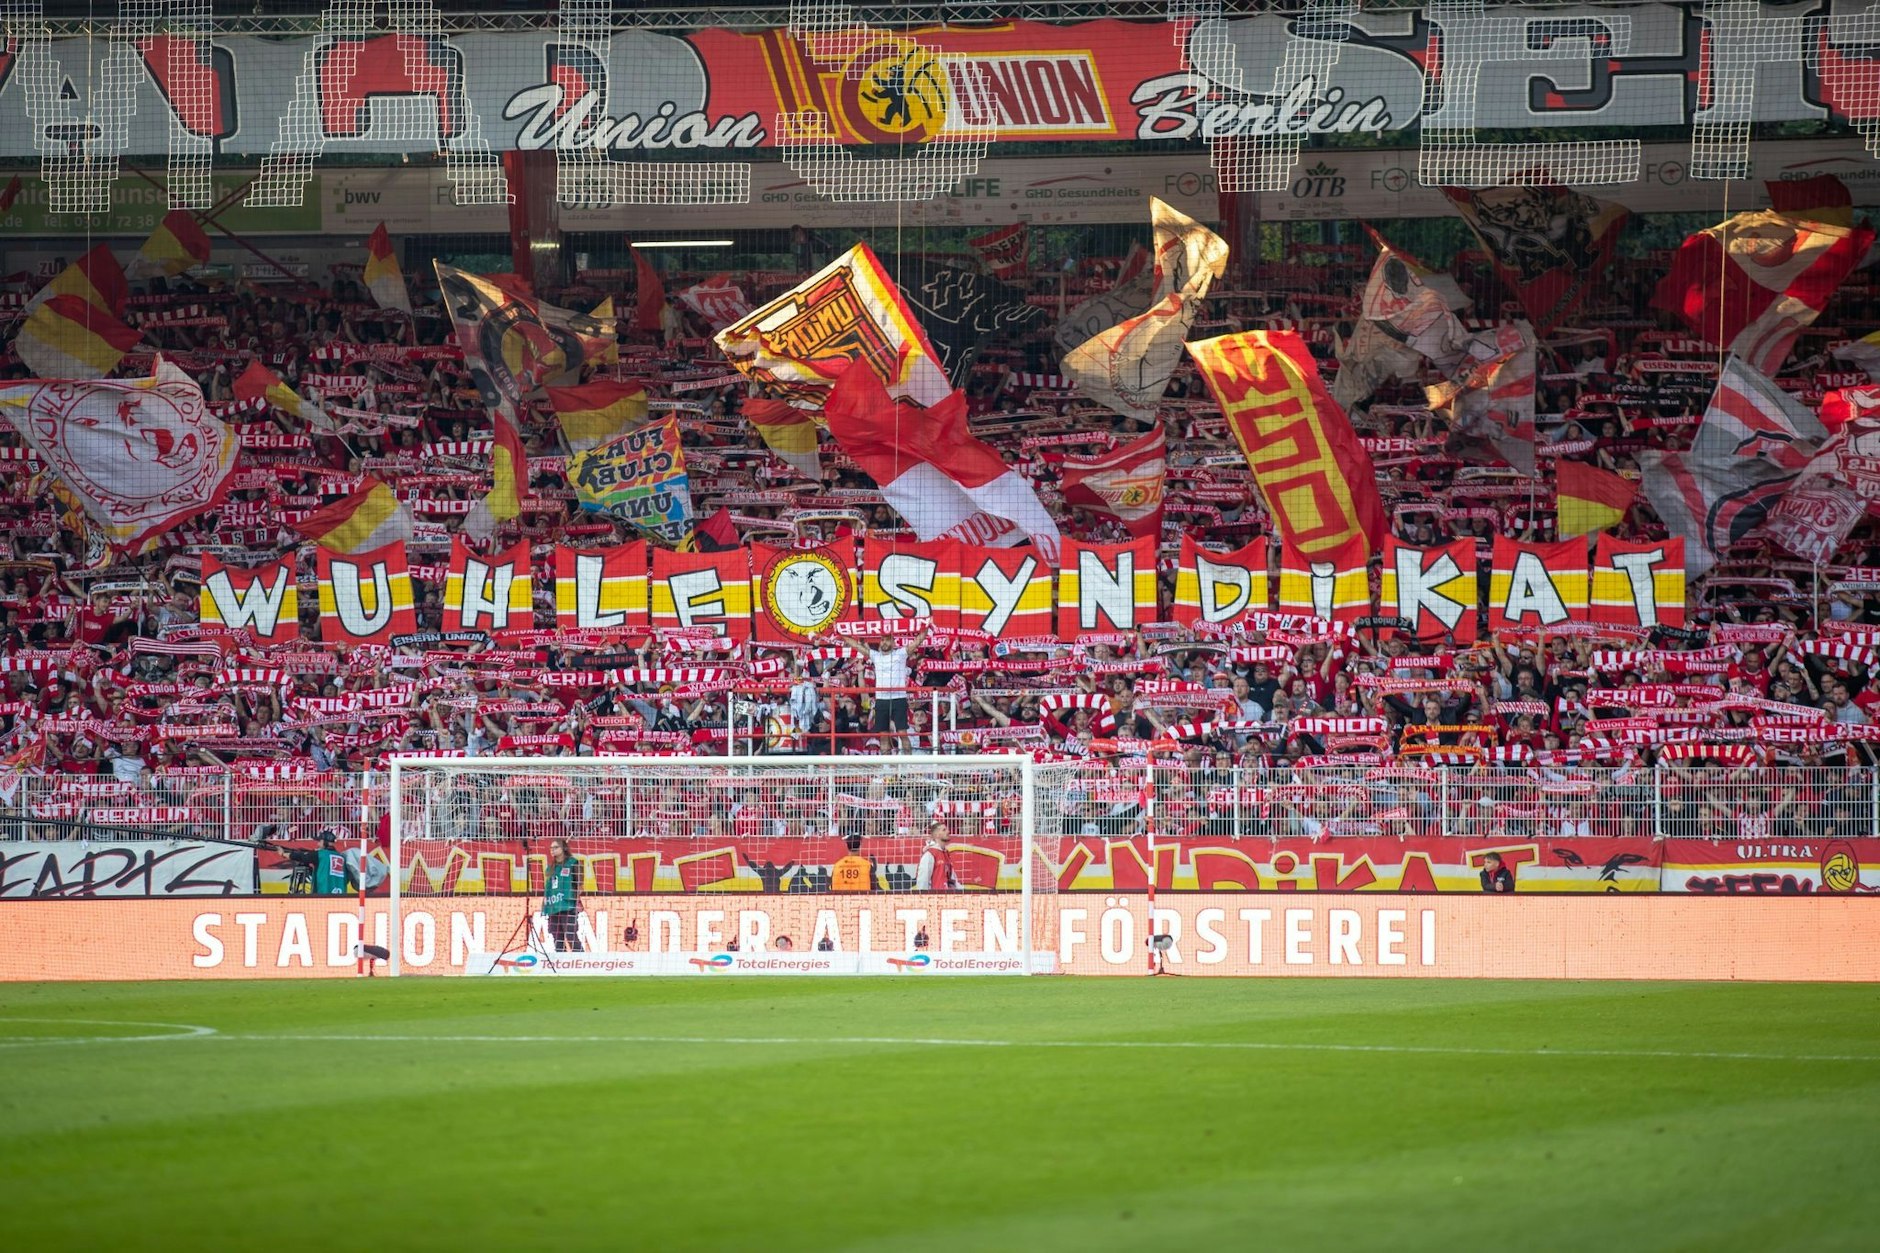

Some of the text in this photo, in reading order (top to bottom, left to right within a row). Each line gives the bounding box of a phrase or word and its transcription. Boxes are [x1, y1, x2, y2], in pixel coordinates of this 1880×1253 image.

[943, 57, 1110, 128] UNION
[502, 80, 766, 150] Union
[1130, 72, 1392, 140] Berlin
[1025, 187, 1141, 200] GHD GesundHeits
[1292, 177, 1346, 198] OTB
[344, 188, 380, 204] bwv
[762, 192, 789, 203] GHD
[1642, 362, 1714, 372] EISERN UNION
[1652, 416, 1696, 426] UNIONER
[204, 551, 728, 640] WUHLE
[393, 632, 487, 648] EISERN UNION
[1394, 656, 1441, 668] UNIONER
[149, 682, 175, 695] Union
[501, 703, 530, 714] Union
[531, 703, 561, 713] Berlin
[1294, 716, 1388, 735] UNION
[1592, 718, 1659, 731] Union Berlin
[512, 734, 561, 746] UNIONER
[1327, 755, 1356, 765] Union
[839, 868, 859, 880] 189
[542, 892, 565, 906] HOST
[192, 912, 487, 968] STADION
[649, 910, 771, 953] DER
[812, 908, 1019, 953] ALTEN
[1059, 896, 1436, 967] FÖRSTEREI
[541, 957, 635, 971] TotalEnergies
[736, 957, 831, 971] TotalEnergies
